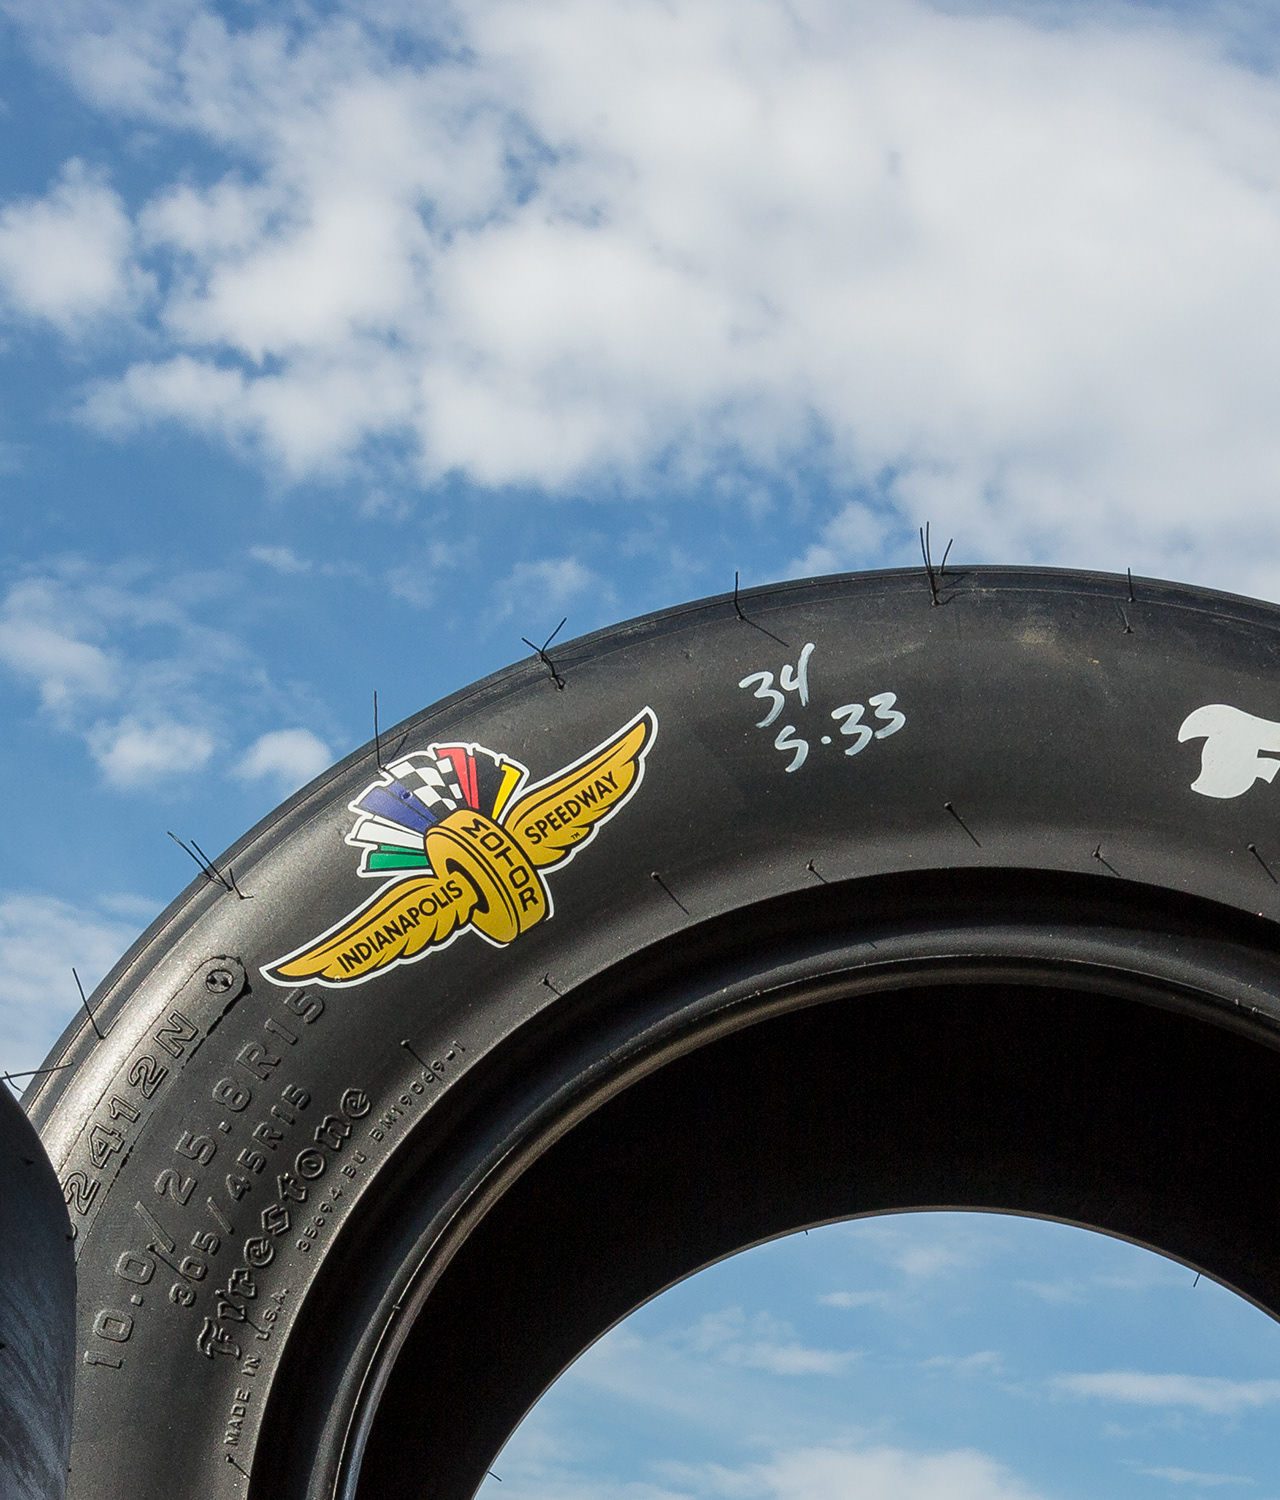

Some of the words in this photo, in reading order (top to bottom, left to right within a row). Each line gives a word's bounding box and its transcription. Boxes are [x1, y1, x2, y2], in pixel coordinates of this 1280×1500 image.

[738, 642, 815, 728] 34
[336, 880, 463, 974] INDIANAPOLIS
[465, 818, 539, 913] MOTOR
[525, 771, 620, 845] SPEEDWAY
[65, 1010, 198, 1220] 2412N
[84, 988, 325, 1370] 10.0/25.8R15
[169, 1084, 312, 1307] 305/45R15
[197, 1088, 371, 1360] Firestone
[223, 1387, 251, 1446] MADE
[241, 1354, 261, 1378] IN
